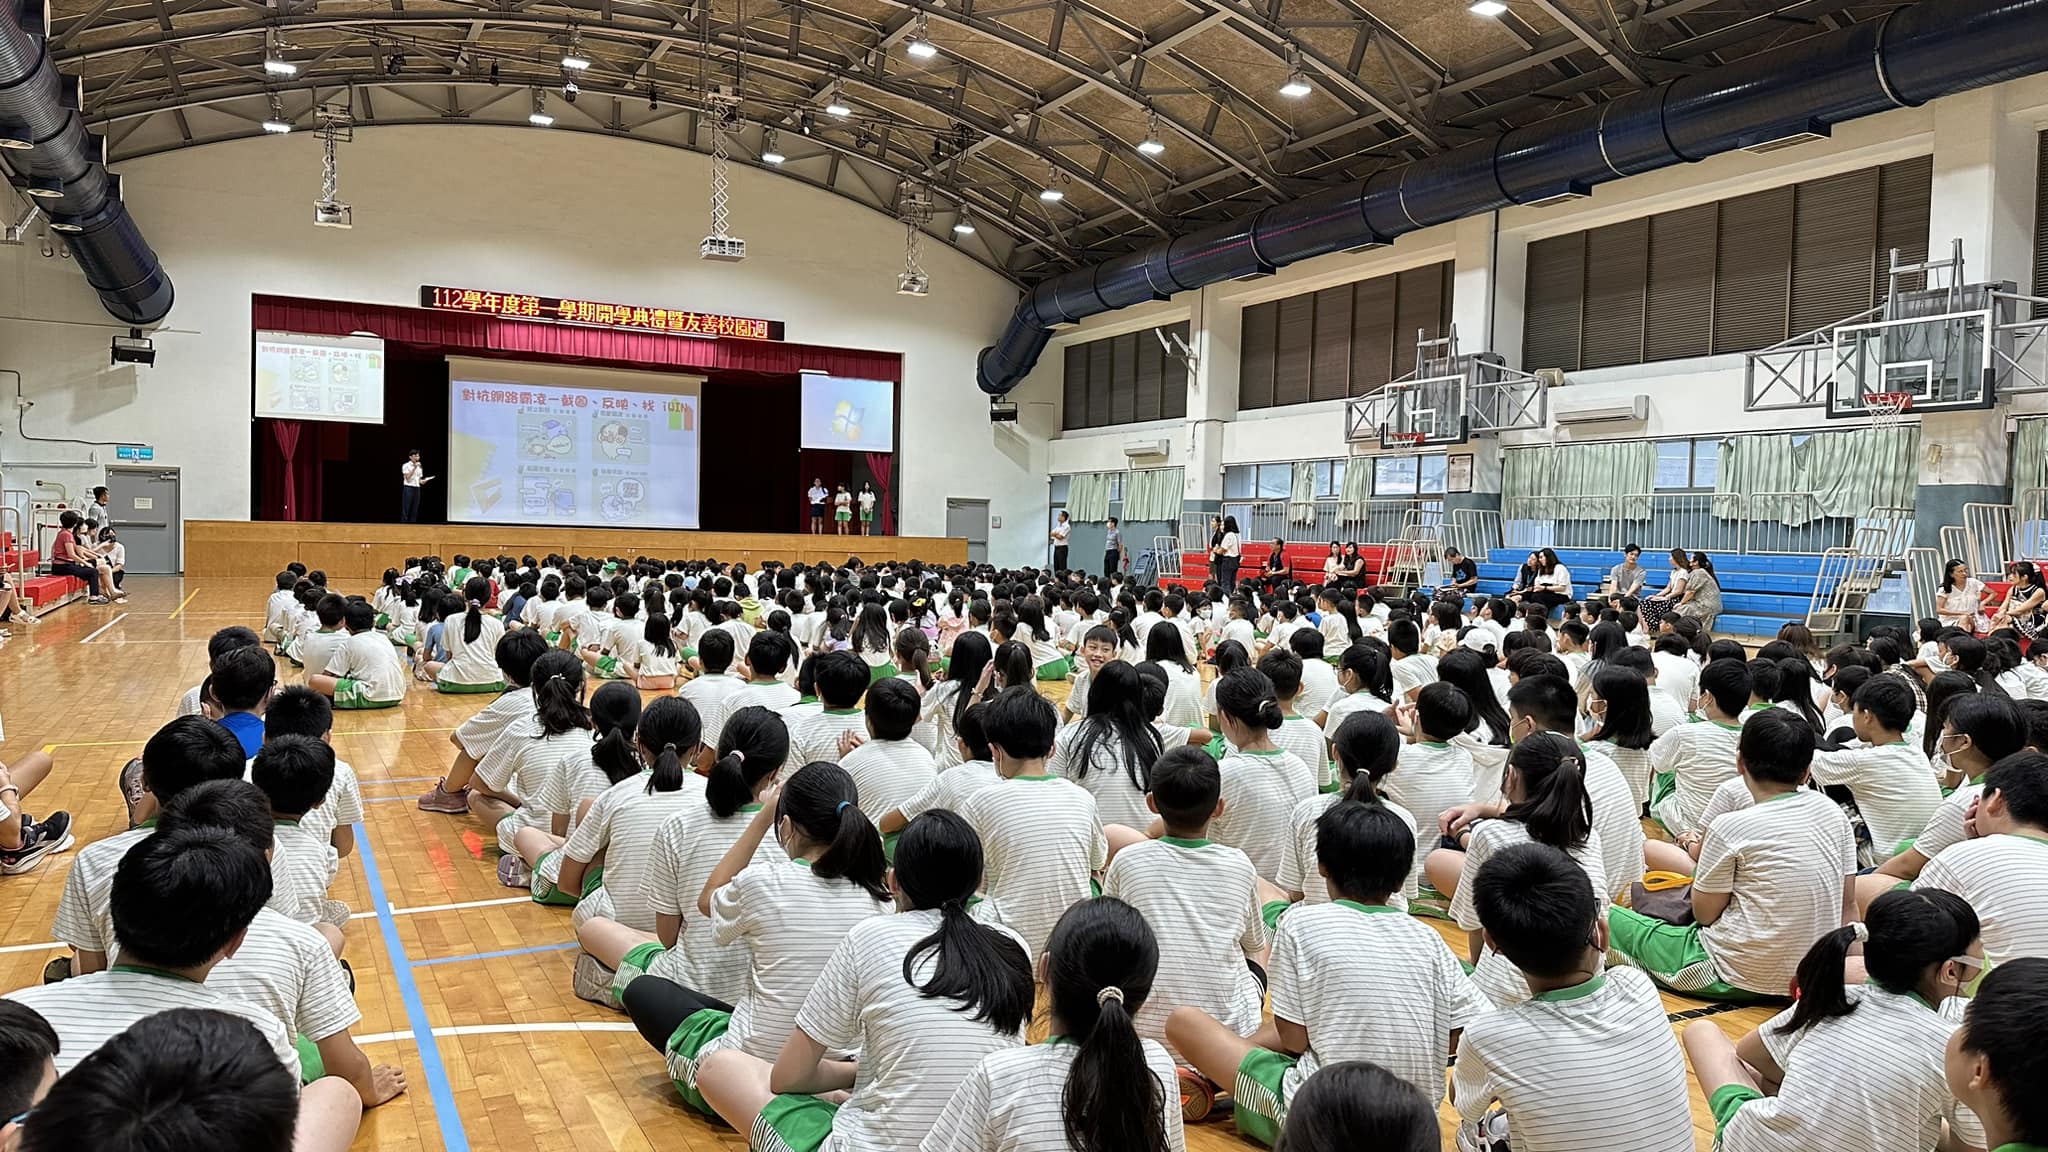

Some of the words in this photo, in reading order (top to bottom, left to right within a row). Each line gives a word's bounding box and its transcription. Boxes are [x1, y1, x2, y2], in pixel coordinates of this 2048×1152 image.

[433, 287, 768, 338] 112學年度第一學期開學典禮暨友善校園週
